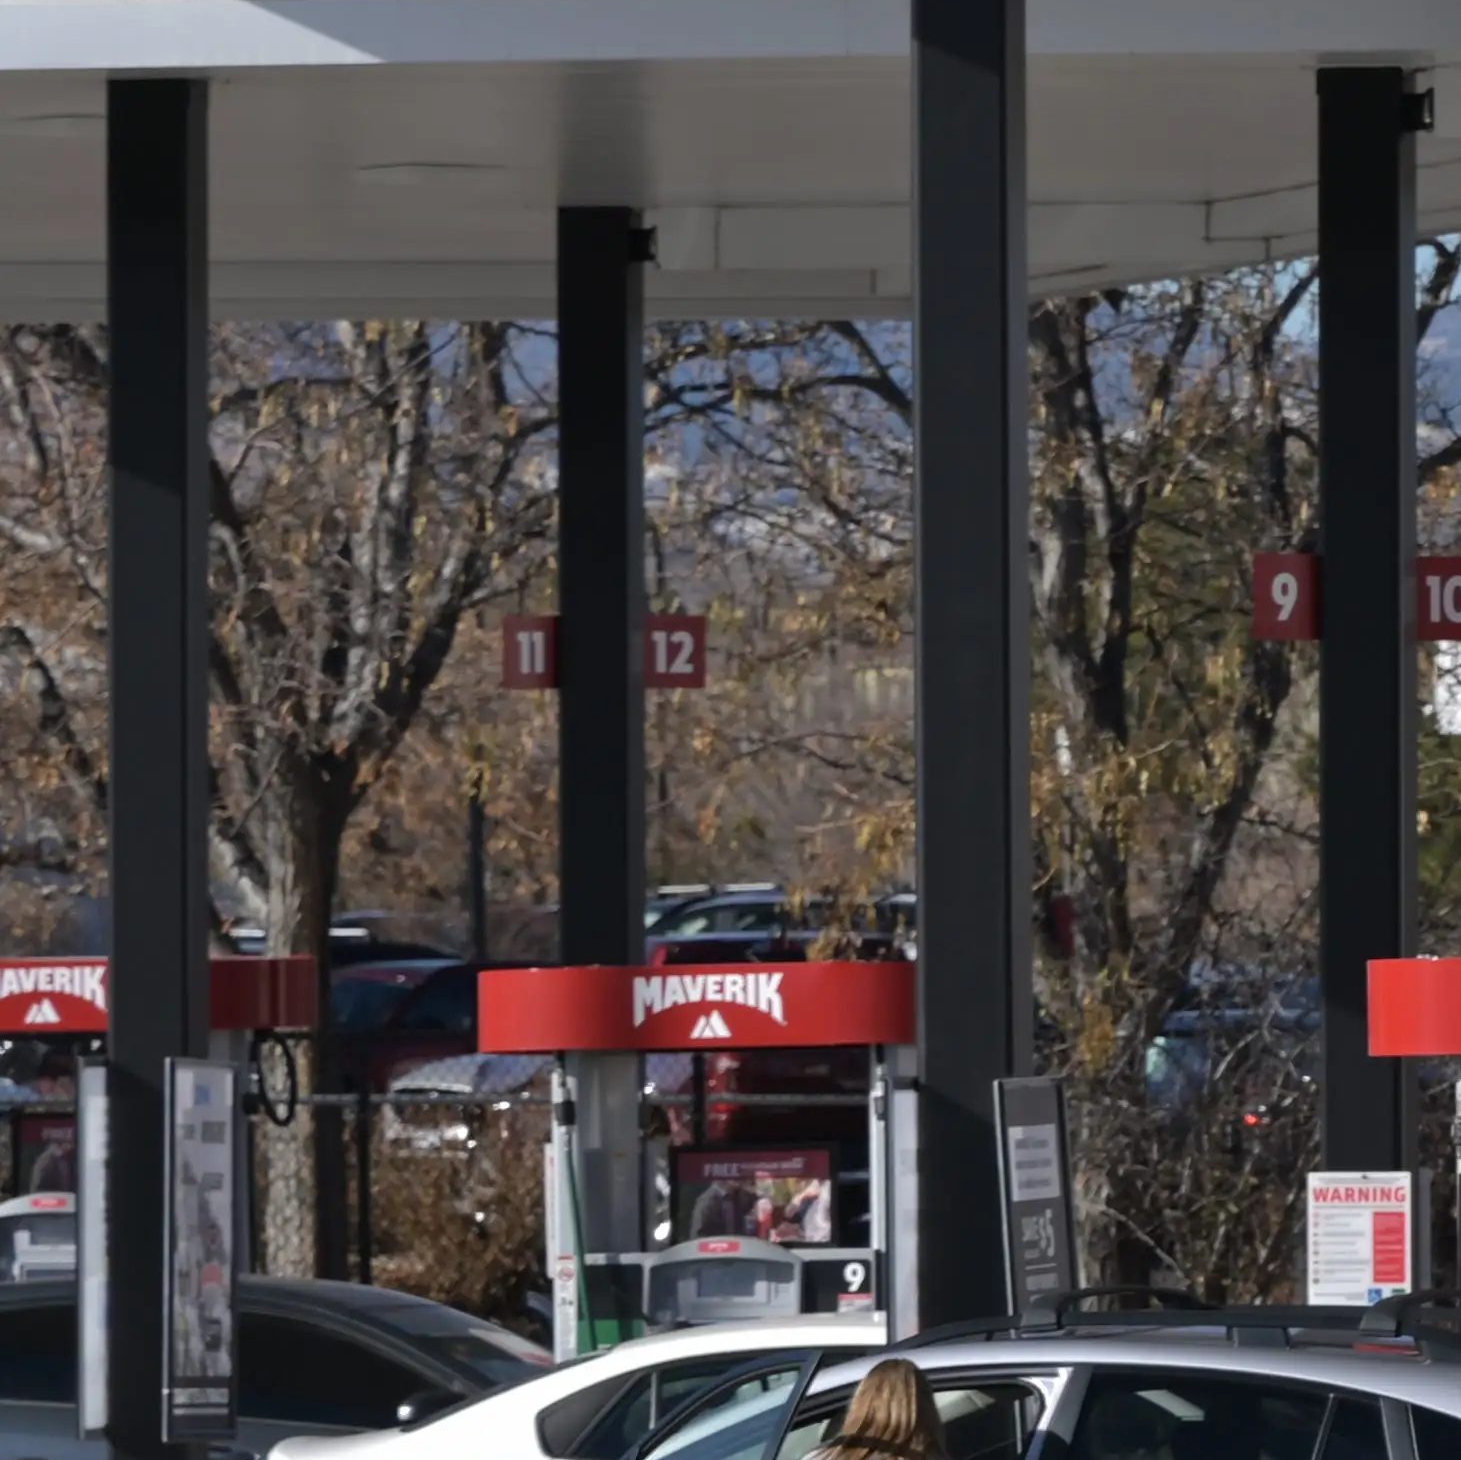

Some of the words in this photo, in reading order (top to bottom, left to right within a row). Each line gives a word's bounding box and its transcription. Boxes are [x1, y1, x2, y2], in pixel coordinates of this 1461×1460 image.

[1271, 572, 1297, 622] 9
[515, 630, 545, 675] 11
[652, 630, 695, 675] 12
[0, 966, 107, 1013] AVERIK
[633, 972, 784, 1026] MAVERIK
[1313, 1186, 1406, 1203] WARNING
[843, 1262, 866, 1293] 9
